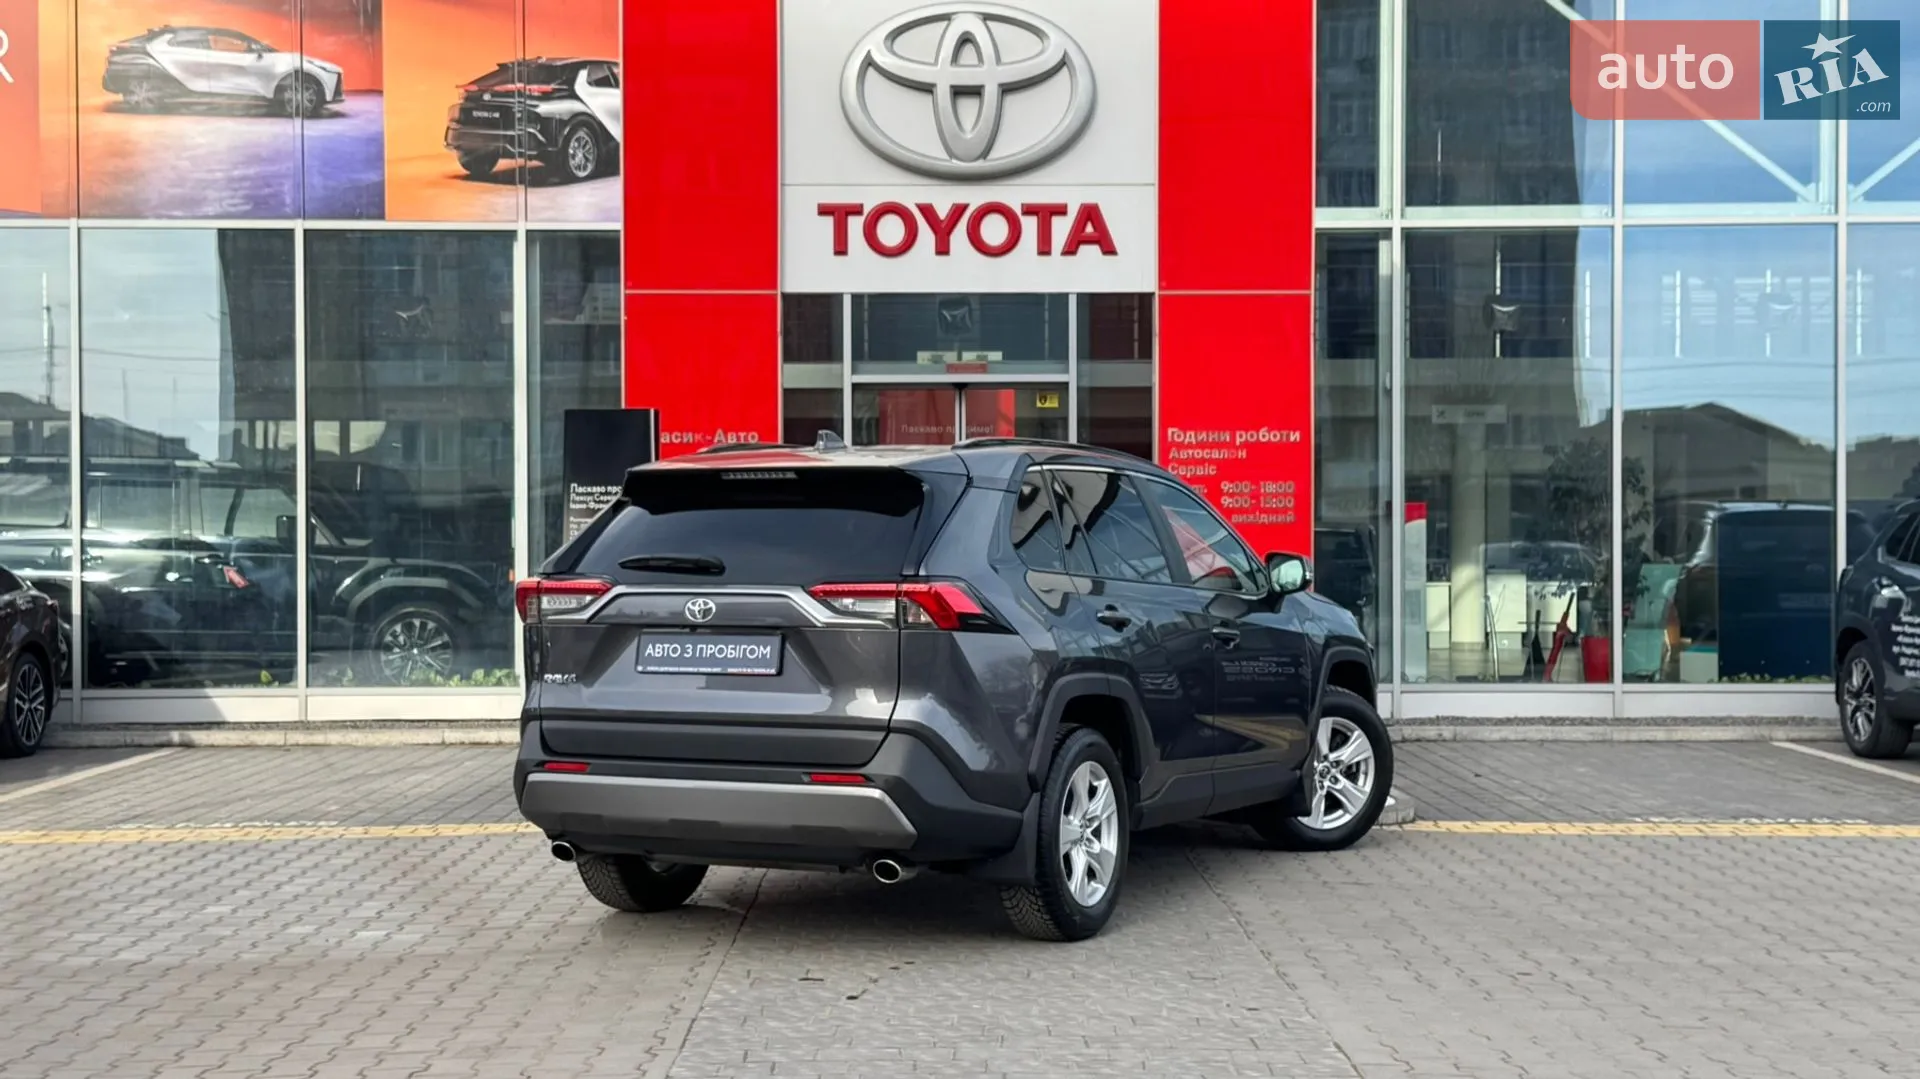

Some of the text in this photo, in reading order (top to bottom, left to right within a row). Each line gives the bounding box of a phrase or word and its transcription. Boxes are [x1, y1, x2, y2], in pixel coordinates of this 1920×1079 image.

[817, 201, 1119, 258] TOYOTA
[1167, 426, 1301, 446] Години роботи
[1168, 447, 1248, 460] Автосалон
[1168, 462, 1217, 478] Сервіс
[644, 643, 681, 658] АВТО
[696, 644, 772, 660] ПРОБІГОМ
